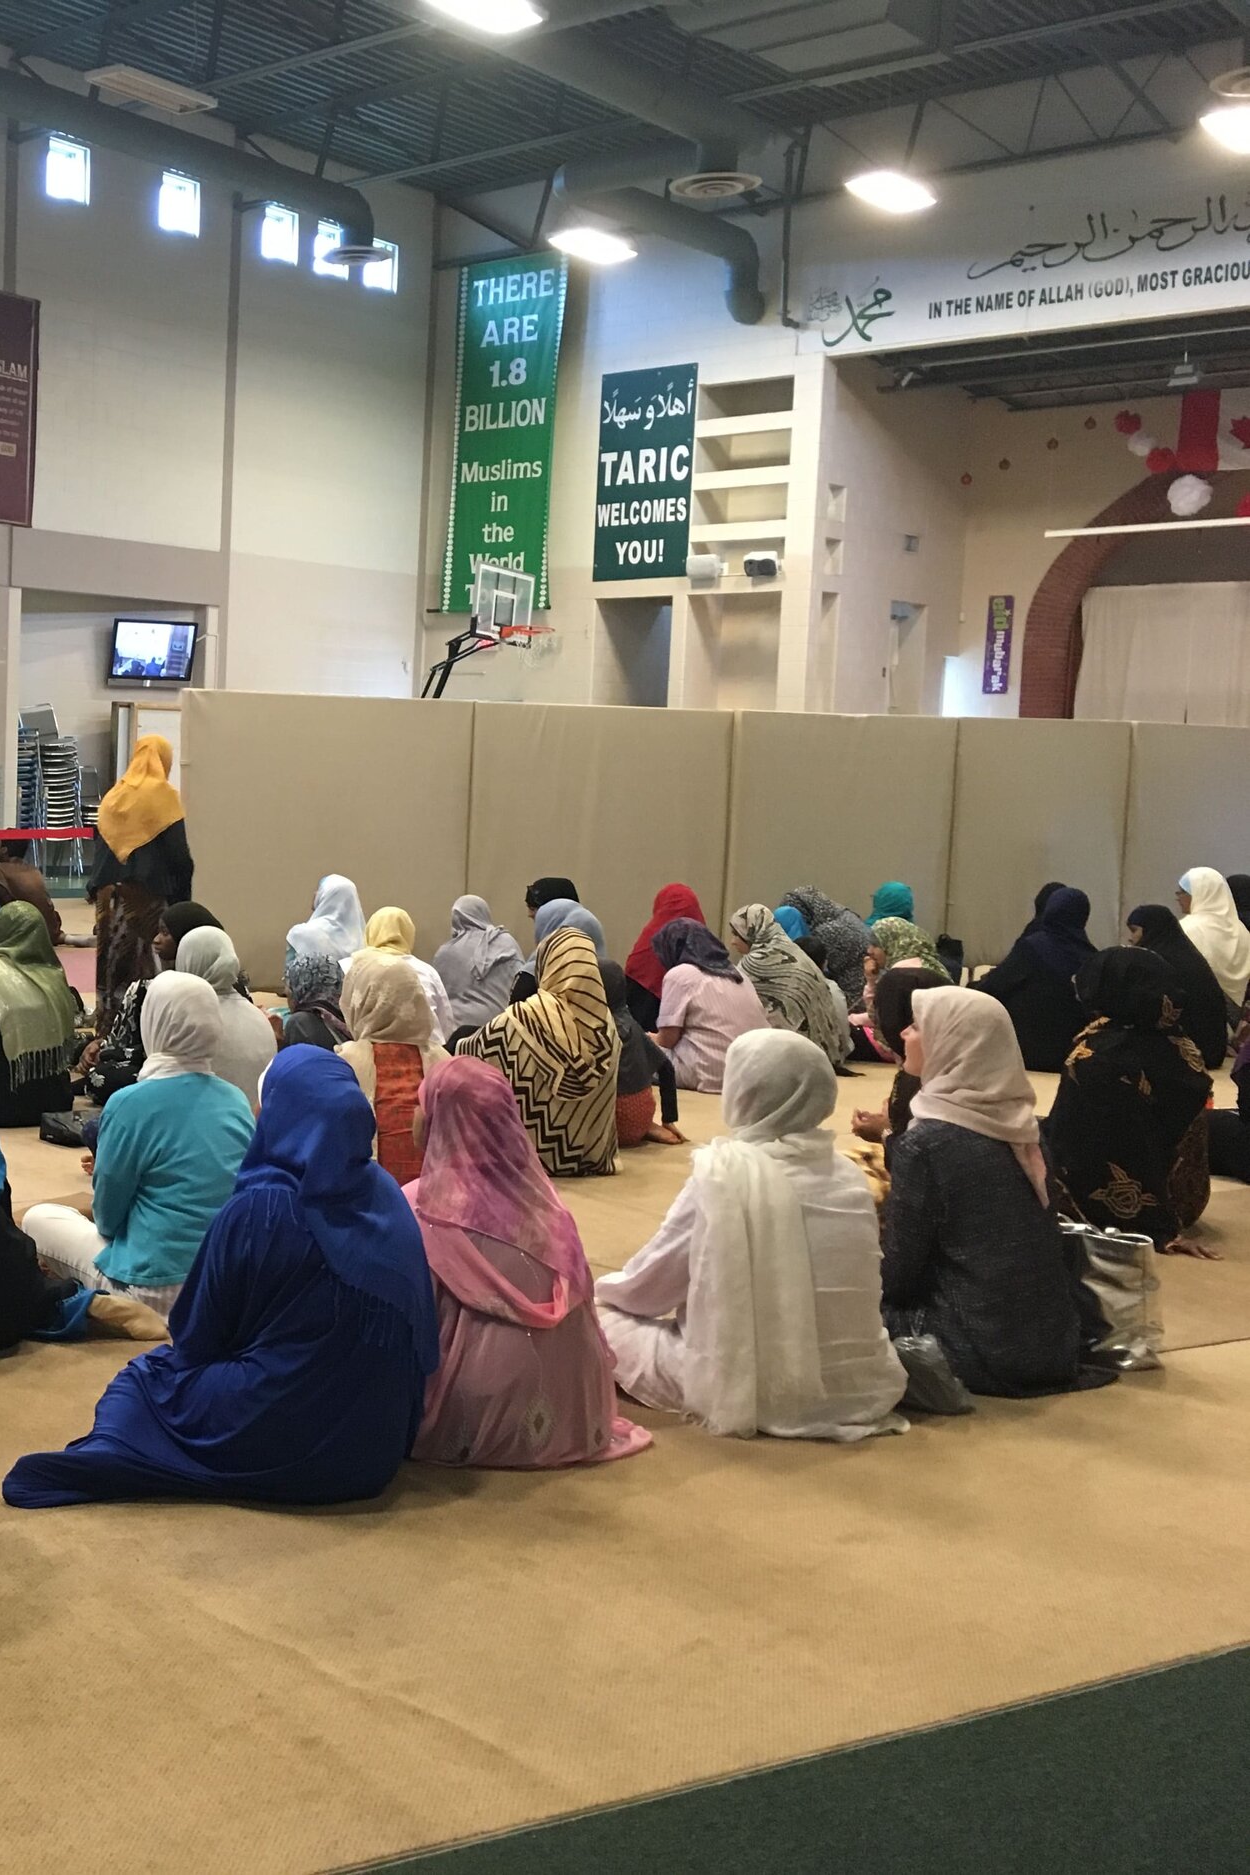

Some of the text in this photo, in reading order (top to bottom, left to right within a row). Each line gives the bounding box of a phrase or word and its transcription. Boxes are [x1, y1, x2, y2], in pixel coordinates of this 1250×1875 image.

[473, 268, 555, 308] THERE
[928, 302, 943, 320] IN
[946, 297, 972, 317] THE
[975, 291, 1014, 313] NAME
[1017, 289, 1036, 308] OF
[1039, 283, 1084, 306] ALLAH
[1137, 270, 1179, 293] MOST
[480, 314, 539, 348] ARE
[489, 357, 527, 388] 1.8
[464, 397, 547, 432] BILLION
[460, 458, 543, 484] Muslims
[600, 444, 690, 487] TARIC
[490, 491, 509, 513] in
[597, 497, 687, 528] WELCOMES
[482, 522, 515, 544] the
[615, 538, 665, 566] YOU!
[992, 597, 1009, 630] eid
[991, 630, 1006, 692] mubarak
